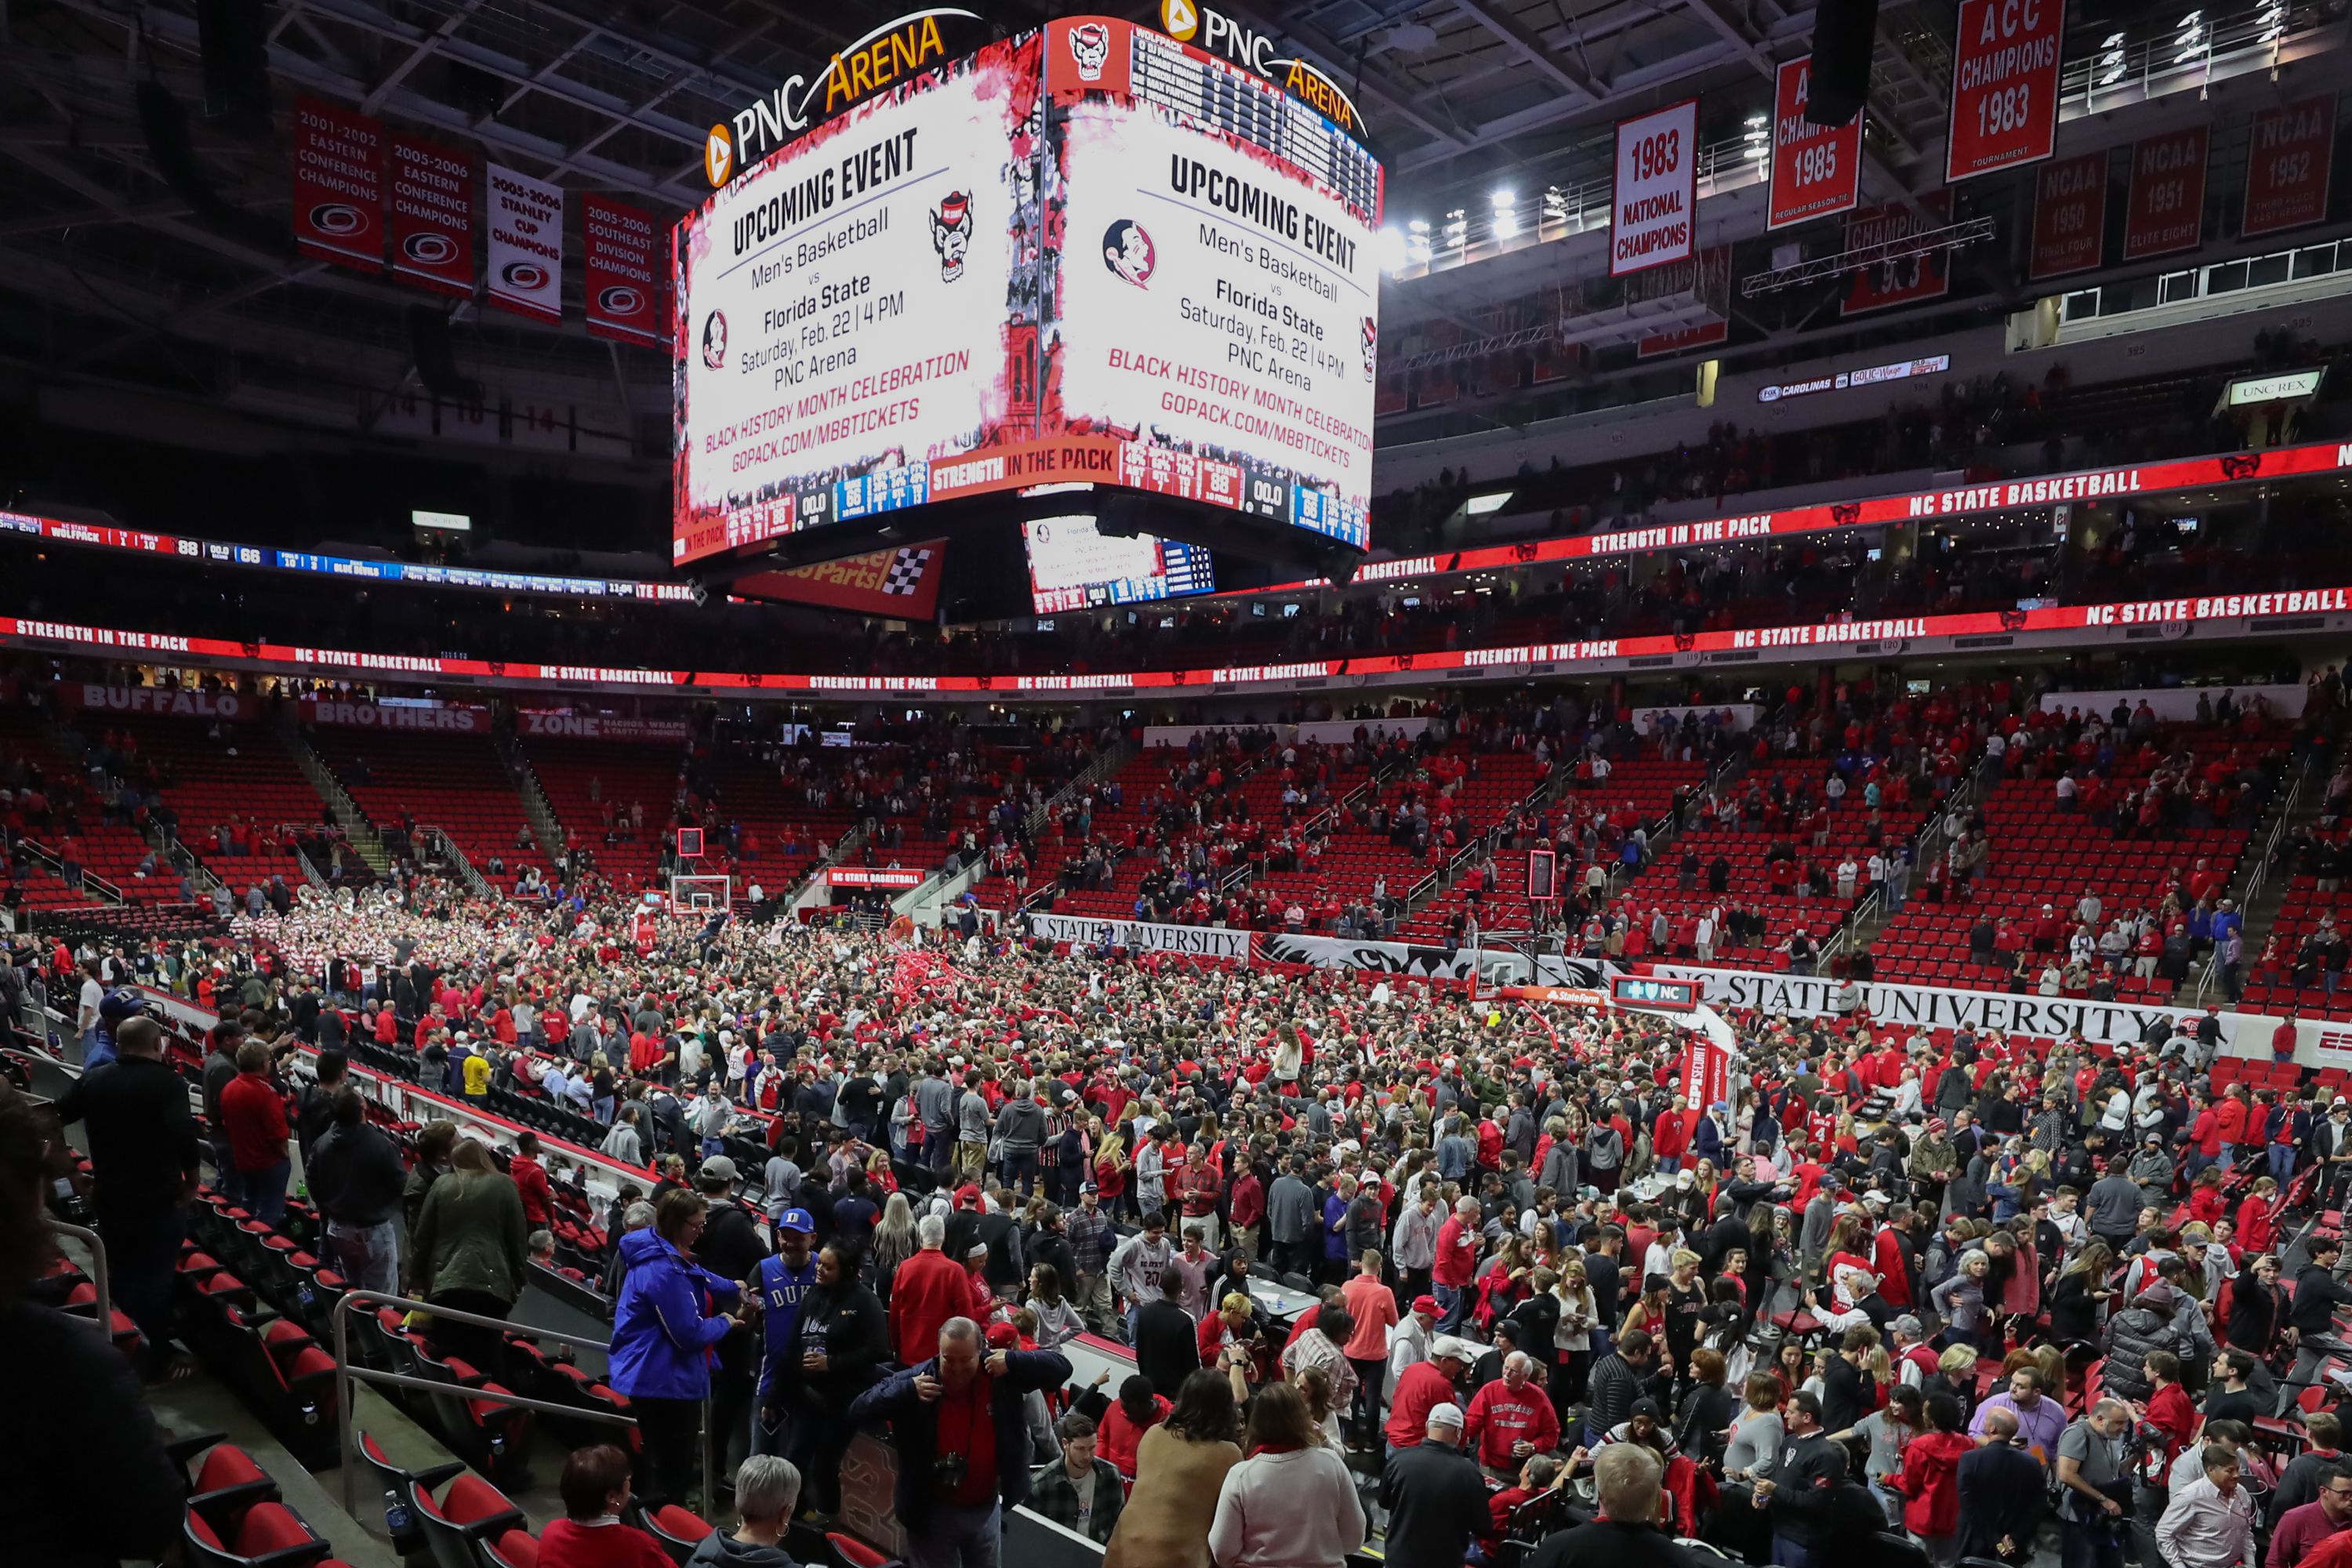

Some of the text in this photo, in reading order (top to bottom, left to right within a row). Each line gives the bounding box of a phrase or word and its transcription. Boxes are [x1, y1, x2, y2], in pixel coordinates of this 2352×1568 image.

[1980, 0, 2039, 45] ACC
[1136, 27, 1183, 53] WOLFPACK
[1203, 6, 1352, 129] PNC ARENA
[1962, 34, 2054, 92] CHAMPIONS
[733, 16, 944, 164] PNC ARENA
[1979, 82, 2029, 138] 1983
[300, 111, 377, 147] 2001-2002
[2262, 108, 2323, 150] NCAA
[310, 133, 367, 162] EASTERN
[394, 145, 468, 178] 2005-2006
[1632, 129, 1679, 182] 1983
[1973, 146, 2029, 168] TOURNAMENT
[2141, 136, 2197, 176] NCAA
[299, 149, 377, 183] CONFERENCE
[404, 165, 459, 193] EASTERN
[1795, 141, 1837, 187] 1985
[2269, 150, 2310, 189] 1952
[299, 168, 378, 201] CHAMPIONS
[394, 181, 468, 213] CONFERENCE
[492, 175, 561, 211] 2005-2006
[734, 127, 918, 256] UPCOMING EVENT
[2045, 162, 2097, 200] NCAA
[501, 196, 552, 224] STANLEY
[1624, 190, 1683, 227] NATIONAL
[1775, 197, 1836, 220] REGULAR SEASON
[2147, 181, 2184, 214] 1951
[396, 200, 468, 231] CHAMPIONS
[514, 218, 539, 236] CUP
[588, 206, 652, 235] 2005-2006
[1171, 154, 1298, 241] UPCOMING
[1304, 213, 1356, 274] EVENT
[2052, 202, 2086, 235] 1950
[492, 227, 560, 261] CHAMPIONS
[589, 223, 652, 251] SOUTHEAST
[1617, 221, 1686, 261] CHAMPIONS
[2067, 238, 2093, 252] FOUR
[2162, 223, 2195, 241] EIGHT
[596, 241, 644, 265] DIVISION
[751, 207, 888, 290] Men's Basketball
[1200, 223, 1338, 303] Men's Basketball
[589, 256, 652, 283] CHAMPIONS
[764, 276, 870, 333] Florida State
[1217, 279, 1324, 342] Florida State
[742, 291, 904, 374] Saturday, Feb. 22 PM
[1181, 298, 1344, 379] Saturday, Feb. 22 PM
[775, 347, 857, 391] PNC Arena
[1229, 343, 1312, 392] PNC Arena
[1853, 368, 1876, 383] GOLIC
[706, 349, 970, 453] BLACK HISTORY MONTH CELEBRATION
[1109, 348, 1374, 455] BLACK HISTORY MONTH CELEBRATION
[1782, 378, 1831, 397] CAROLINAS
[2242, 378, 2308, 399] UNC REX
[733, 397, 920, 472] GOPACK.COM/MBBTICKETS
[1161, 392, 1351, 469] GOPACK.COM/MBBTICKETS
[933, 447, 1112, 491] STRENGTH IN THE PACK
[1210, 472, 1229, 494] 88
[802, 493, 826, 516] 00.0
[1254, 480, 1282, 506] 00.0
[1909, 470, 2141, 517] NC STATE BASKETBALL
[51, 526, 100, 543] WOLFPACK
[178, 539, 198, 556] 88
[1592, 514, 1772, 554] STRENGTH IN THE PACK
[240, 547, 261, 564] 66
[1363, 557, 1436, 581] BASKETBALL
[2086, 589, 2348, 626] NC STATE BASKETBALL
[16, 620, 189, 652] STRENGTH IN THE PACK
[1733, 619, 1927, 649] NC STATE BASKETBALL
[295, 648, 442, 673] NC STATE BASKETBALL
[1464, 639, 1618, 667] STRENGTH IN THE PACK
[540, 666, 673, 684] NC STATE BASKETBALL
[809, 675, 938, 691] STRENGTH IN THE PACK
[1018, 674, 1134, 691] NC STATE BASKETBALL
[1213, 662, 1328, 684] NC STATE BASKETBALL
[82, 684, 239, 717] BUFFALO
[315, 701, 474, 730] BROTHERS
[528, 714, 600, 735] ZONE
[648, 720, 687, 730] WRAPS
[845, 873, 919, 885] STATE BASKETBALL
[1660, 985, 1680, 1000] NC
[1727, 975, 2161, 1043] STATE UNIVERSITY
[1687, 1040, 1707, 1110] CPI SECURITY
[1815, 1127, 1825, 1142] 4
[786, 1212, 799, 1223] D
[1144, 1270, 1160, 1287] 20
[771, 1285, 811, 1308] DUK
